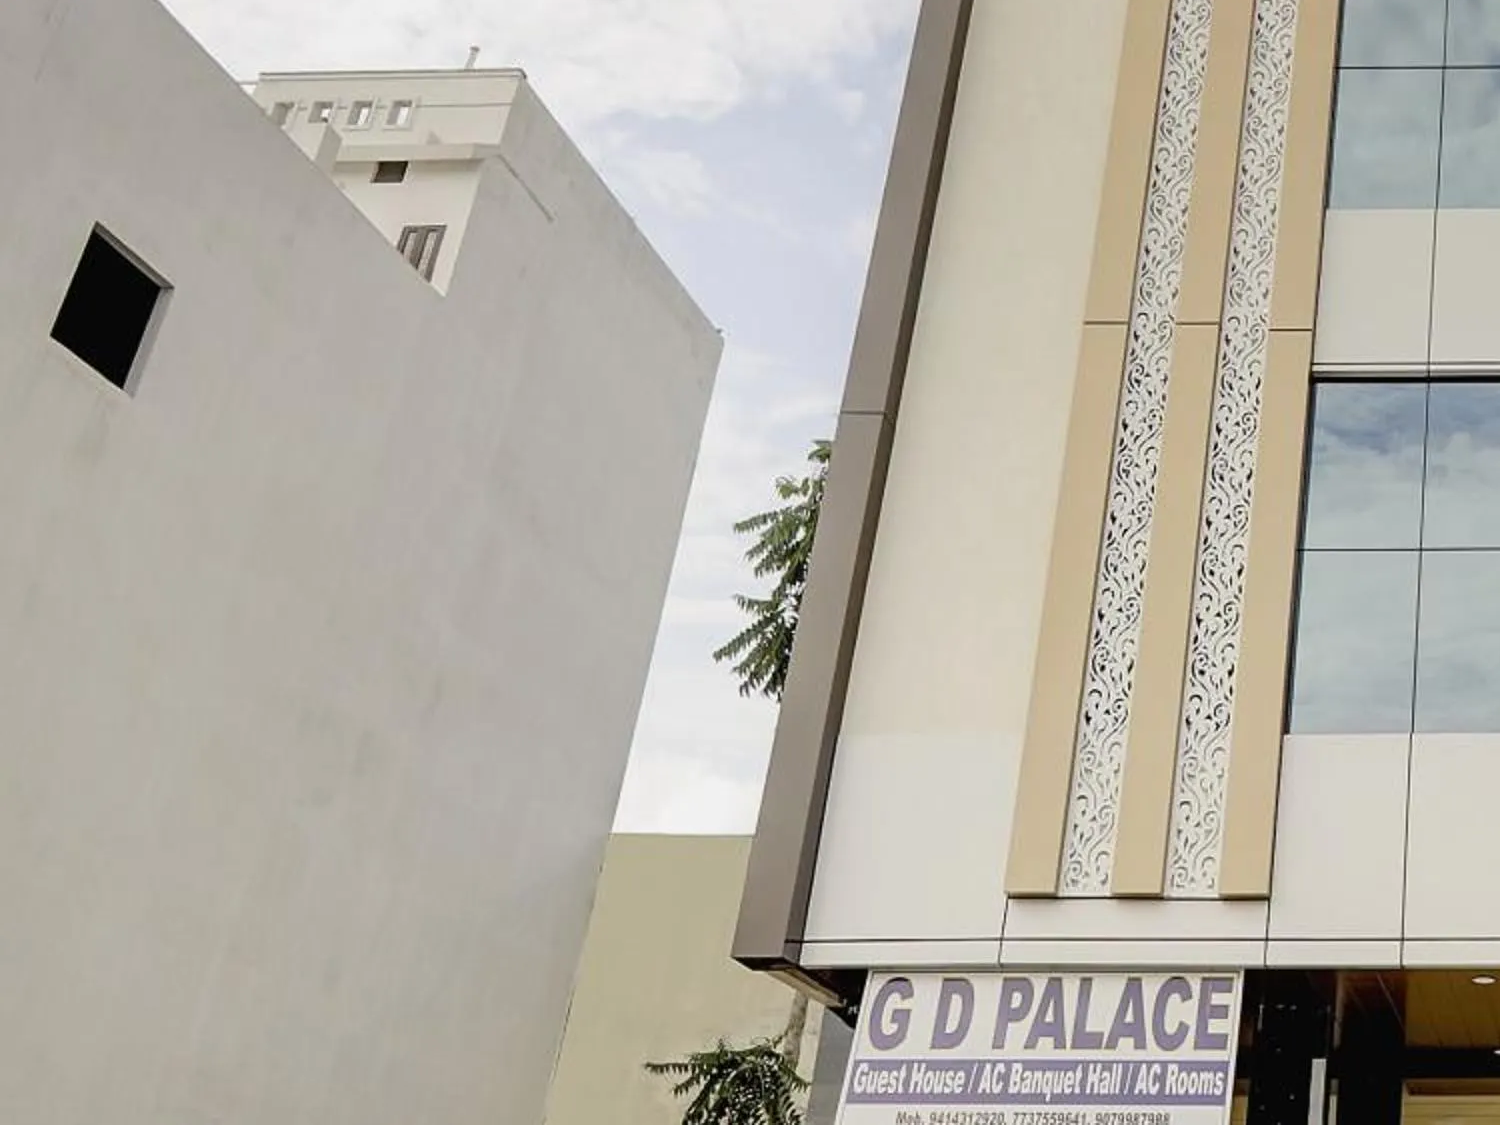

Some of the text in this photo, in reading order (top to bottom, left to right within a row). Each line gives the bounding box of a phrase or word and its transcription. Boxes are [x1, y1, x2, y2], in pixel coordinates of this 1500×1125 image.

[869, 977, 1233, 1051] G D PALACE
[853, 1062, 907, 1094] Guest
[908, 1062, 966, 1094] House
[978, 1062, 1006, 1094] AC
[1007, 1062, 1083, 1102] Banquet
[1085, 1063, 1123, 1095] Hall
[1133, 1063, 1162, 1095] AC
[1165, 1063, 1225, 1096] Rooms
